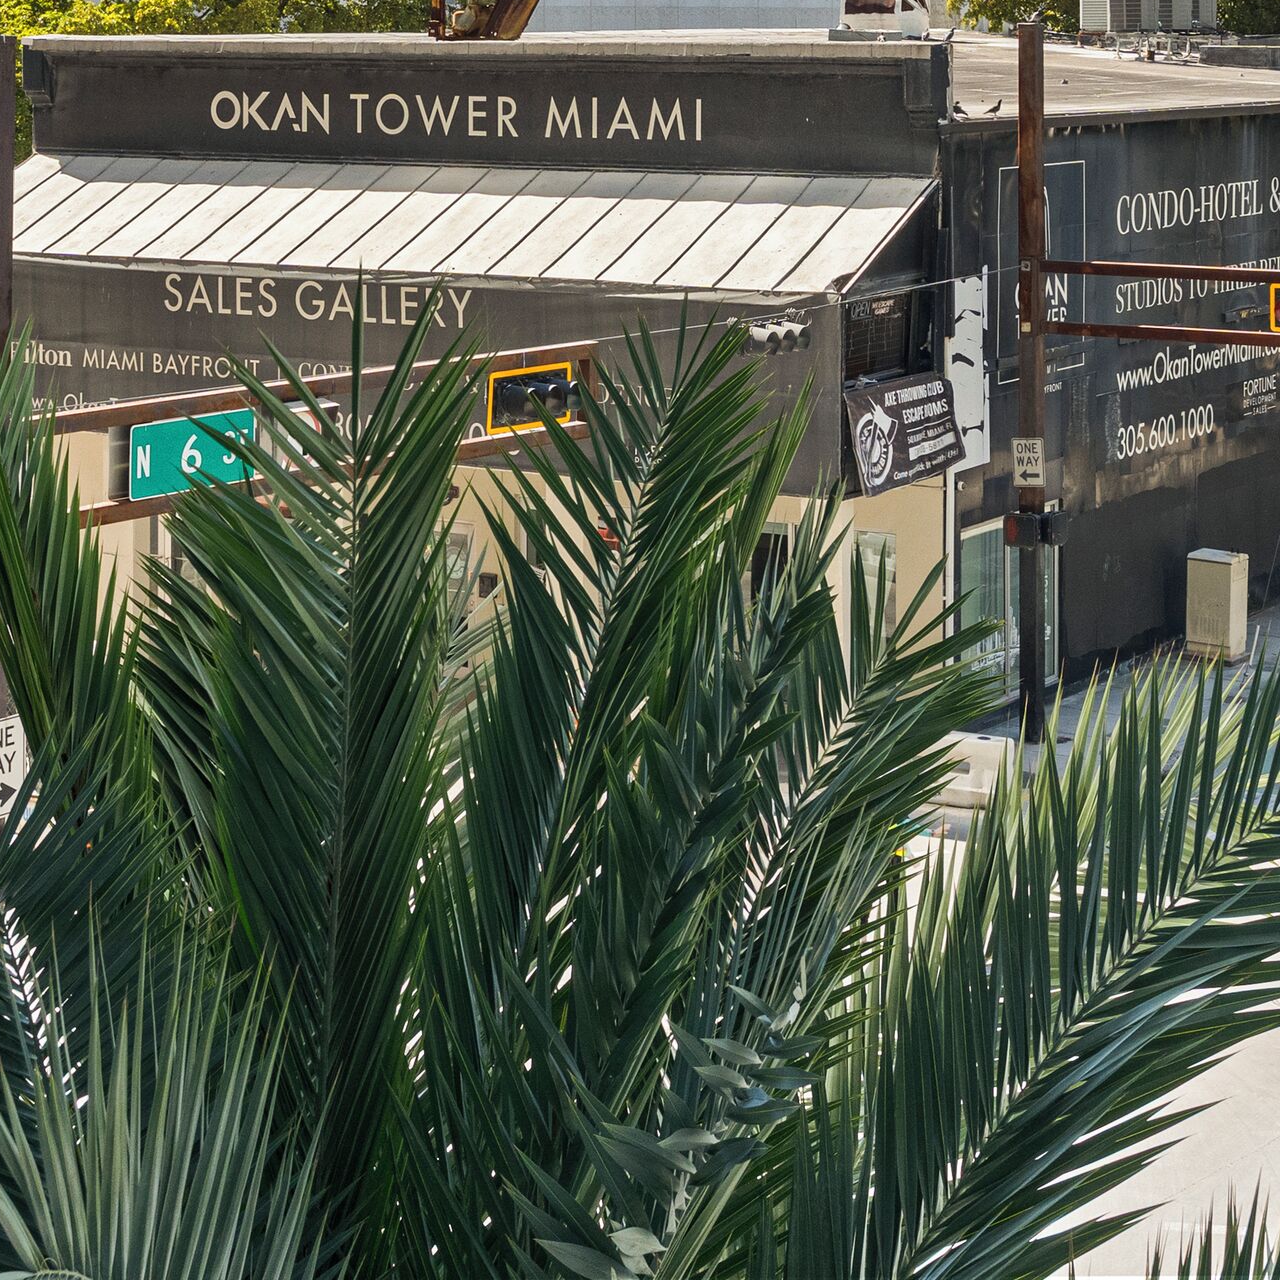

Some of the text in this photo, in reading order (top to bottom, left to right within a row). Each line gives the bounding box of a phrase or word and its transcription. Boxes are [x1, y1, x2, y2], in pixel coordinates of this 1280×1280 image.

[210, 90, 702, 141] OKAN TOWER MIAMI
[1116, 179, 1263, 235] CONDO-HOTEL
[163, 273, 472, 330] SALES GALLERY
[1116, 277, 1183, 314] STUDIOS
[1186, 278, 1208, 300] TO
[82, 348, 144, 372] MIAMI
[153, 351, 260, 379] BAYFROT
[884, 391, 898, 408] AXE
[927, 380, 944, 397] CUB
[1243, 373, 1277, 398] FORTUNE
[1016, 442, 1038, 454] ONE
[1117, 403, 1214, 460] 305.600.1000
[136, 444, 151, 479] N
[181, 434, 203, 475] 6
[1016, 456, 1040, 467] WAY
